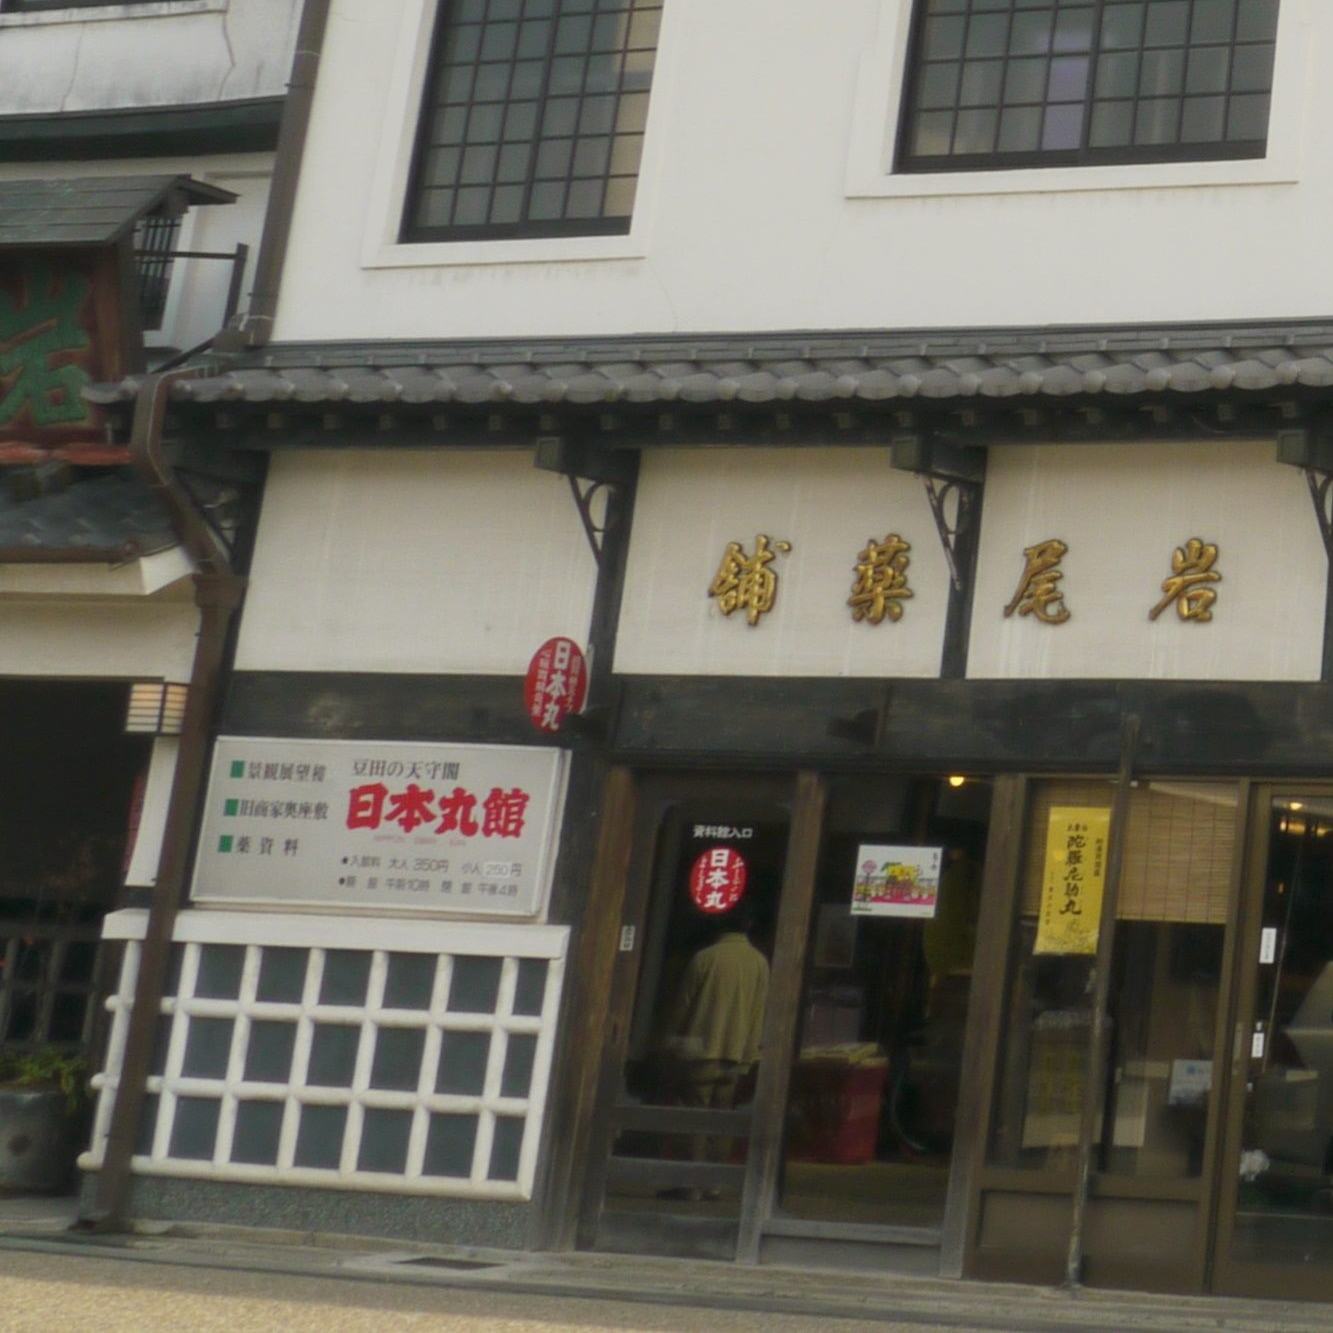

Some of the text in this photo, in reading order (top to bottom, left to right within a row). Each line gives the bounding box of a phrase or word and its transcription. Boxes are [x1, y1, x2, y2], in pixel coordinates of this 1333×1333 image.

[541, 640, 571, 730] 日本丸
[353, 758, 460, 781] 豆田の天守閣
[346, 781, 530, 838] 日本丸館
[693, 825, 753, 839] 資料館入口
[704, 848, 729, 909] 日本丸
